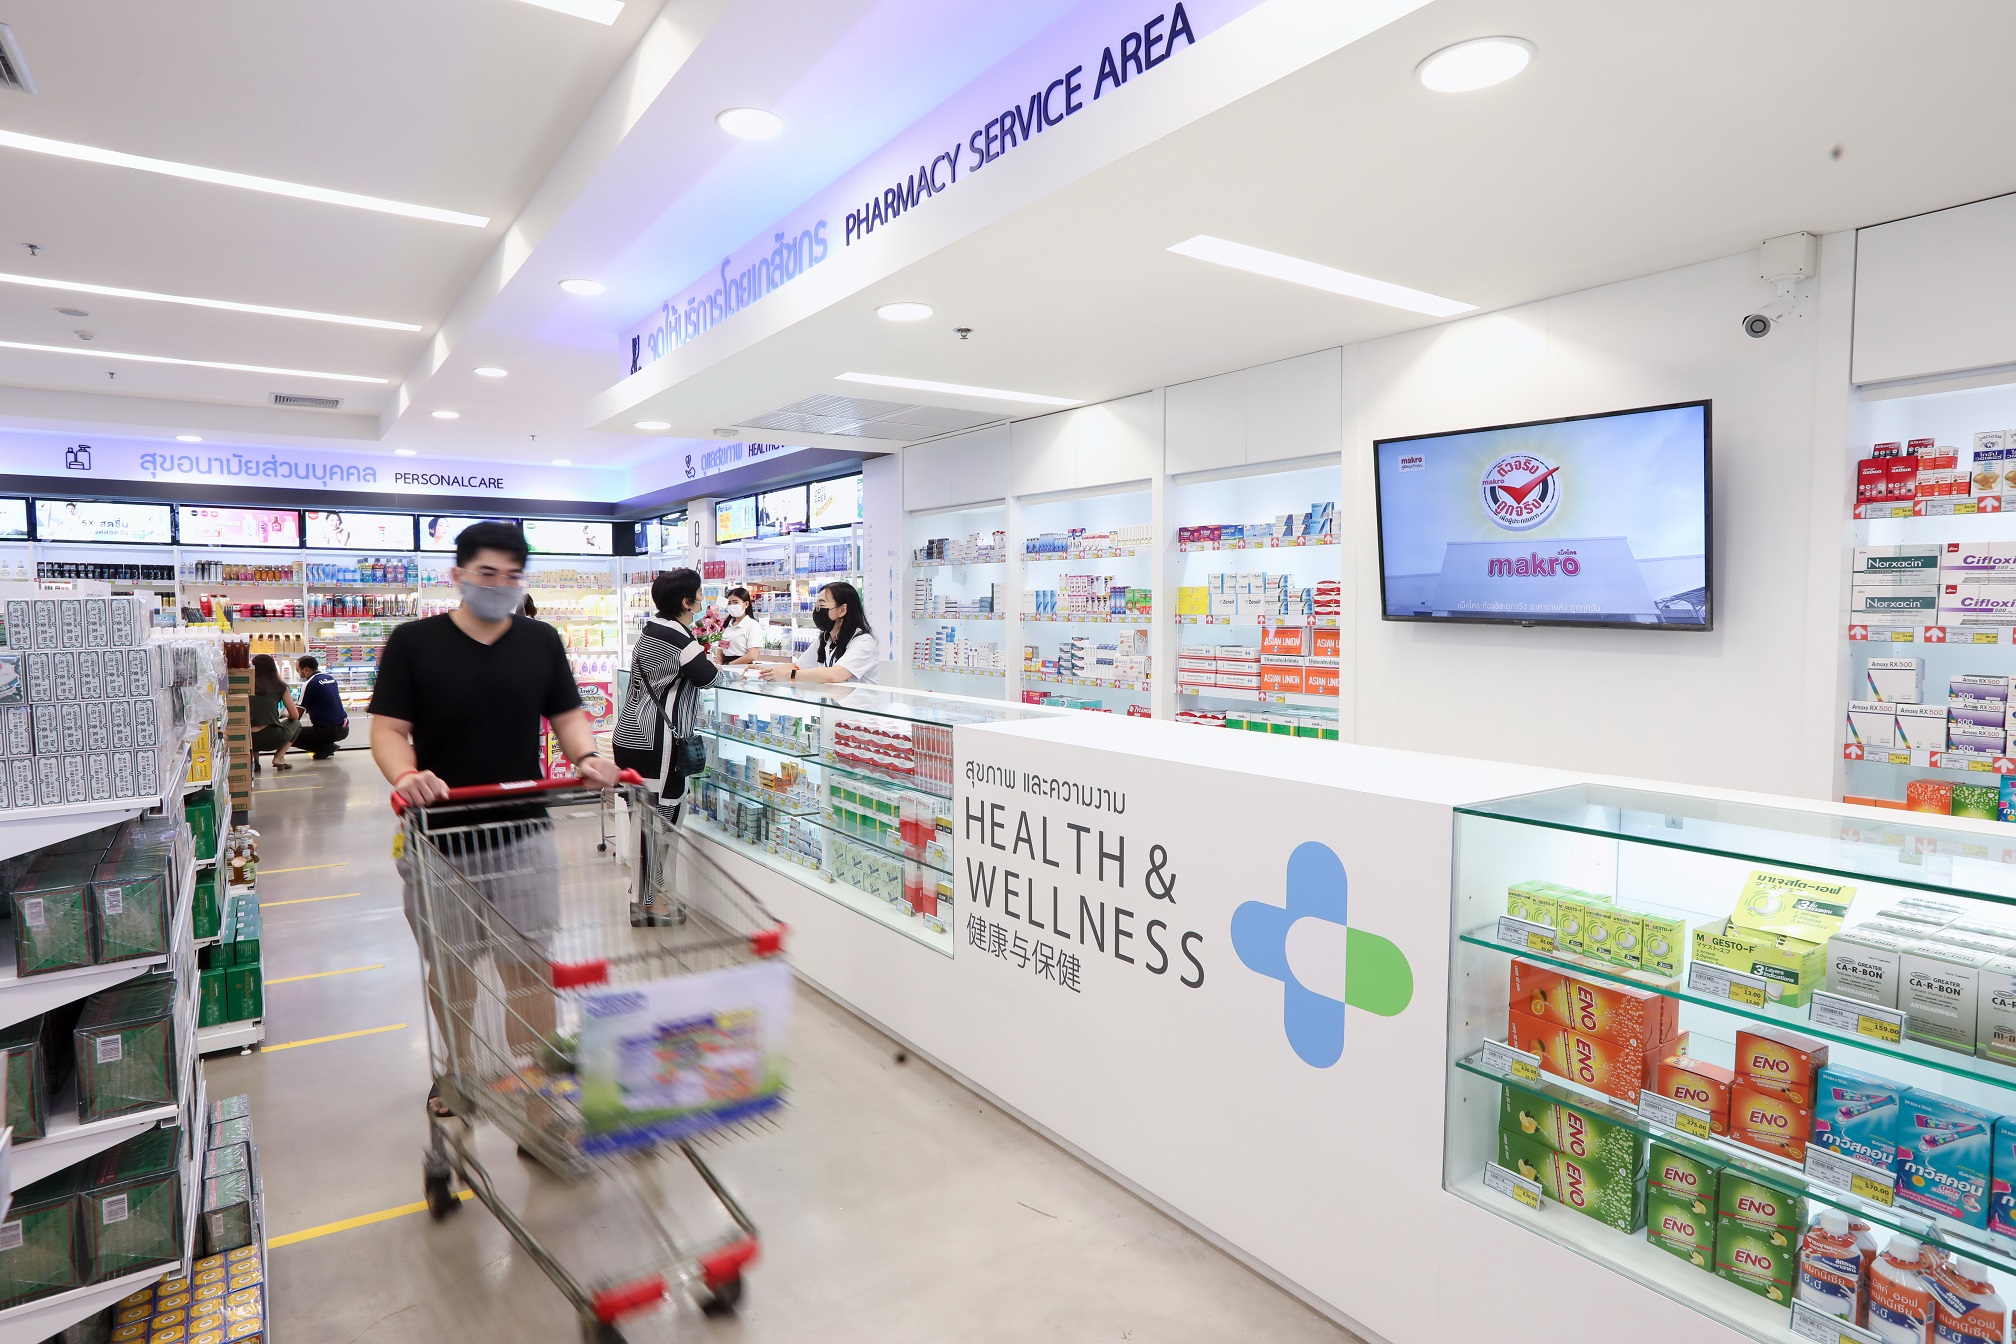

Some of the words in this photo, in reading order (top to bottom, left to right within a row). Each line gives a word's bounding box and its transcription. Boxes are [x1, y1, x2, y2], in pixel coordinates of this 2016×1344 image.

[844, 143, 962, 246] PHARMACY
[968, 65, 1084, 172] SERVICE
[1093, 1, 1196, 100] AREA
[648, 220, 828, 361] จดให้บริการโดยเภสัชกร
[139, 452, 377, 487] สุขอนามัยส่วนบุคคล
[1497, 459, 1540, 478] ตัวจริง
[394, 472, 504, 489] PERSONALCARE
[1482, 478, 1505, 486] makro
[1488, 552, 1581, 577] makro
[1867, 558, 1922, 569] Norxacin
[1866, 598, 1921, 608] Norxacin
[1264, 637, 1282, 646] ASIAN
[1282, 637, 1300, 646] UNION
[1317, 639, 1335, 648] ASIAN
[1264, 674, 1282, 683] ASIAN
[1282, 675, 1300, 684] UNION
[1308, 676, 1326, 686] ASIAN
[966, 760, 1016, 788] สุขภาพ
[1023, 772, 1126, 814] และความงาม
[965, 796, 1125, 888] HEALTH
[1144, 844, 1177, 904] &
[1757, 875, 1843, 895] มาเจสโต-เอฟ
[1797, 900, 1810, 909] 3
[966, 856, 1205, 989] WELLNESS
[966, 912, 1082, 994] 健康与保健
[1753, 965, 1764, 976] 3
[1764, 967, 1785, 975] Layers
[1836, 962, 1883, 979] CA-R-BON
[1858, 961, 1882, 972] GREATER
[1763, 971, 1795, 983] Indications
[1933, 977, 1961, 988] GREATER
[1909, 978, 1961, 996] CA-R-BON
[1577, 985, 1598, 1032] ENO
[1874, 1025, 1900, 1035] 159.00
[1881, 1035, 1899, 1044] 15.90
[1575, 1036, 1596, 1084] ENO
[1752, 1055, 1790, 1073] ENO
[1674, 1086, 1710, 1102] ENO
[1687, 1119, 1707, 1131] 275.00
[1749, 1110, 1789, 1129] ENO
[1567, 1111, 1587, 1158] ENO
[1823, 1130, 1894, 1163] กาวิสคอน
[1566, 1161, 1586, 1208] ENO
[1663, 1167, 1697, 1186] ENO
[1904, 1158, 1984, 1197] กาวิสคอน
[1865, 1182, 1890, 1196] 570.00
[1737, 1197, 1777, 1217] ENO
[1871, 1195, 1888, 1205] 23.75
[1662, 1217, 1695, 1237] ENO
[1733, 1249, 1773, 1270] ENO
[1872, 1279, 1888, 1295] มิลค์
[1892, 1293, 1918, 1307] ออฟ
[1871, 1290, 1913, 1316] แมกนีเซีย
[1940, 1313, 1990, 1339] แมกนีเซีย
[1968, 1316, 1996, 1332] ออฟ
